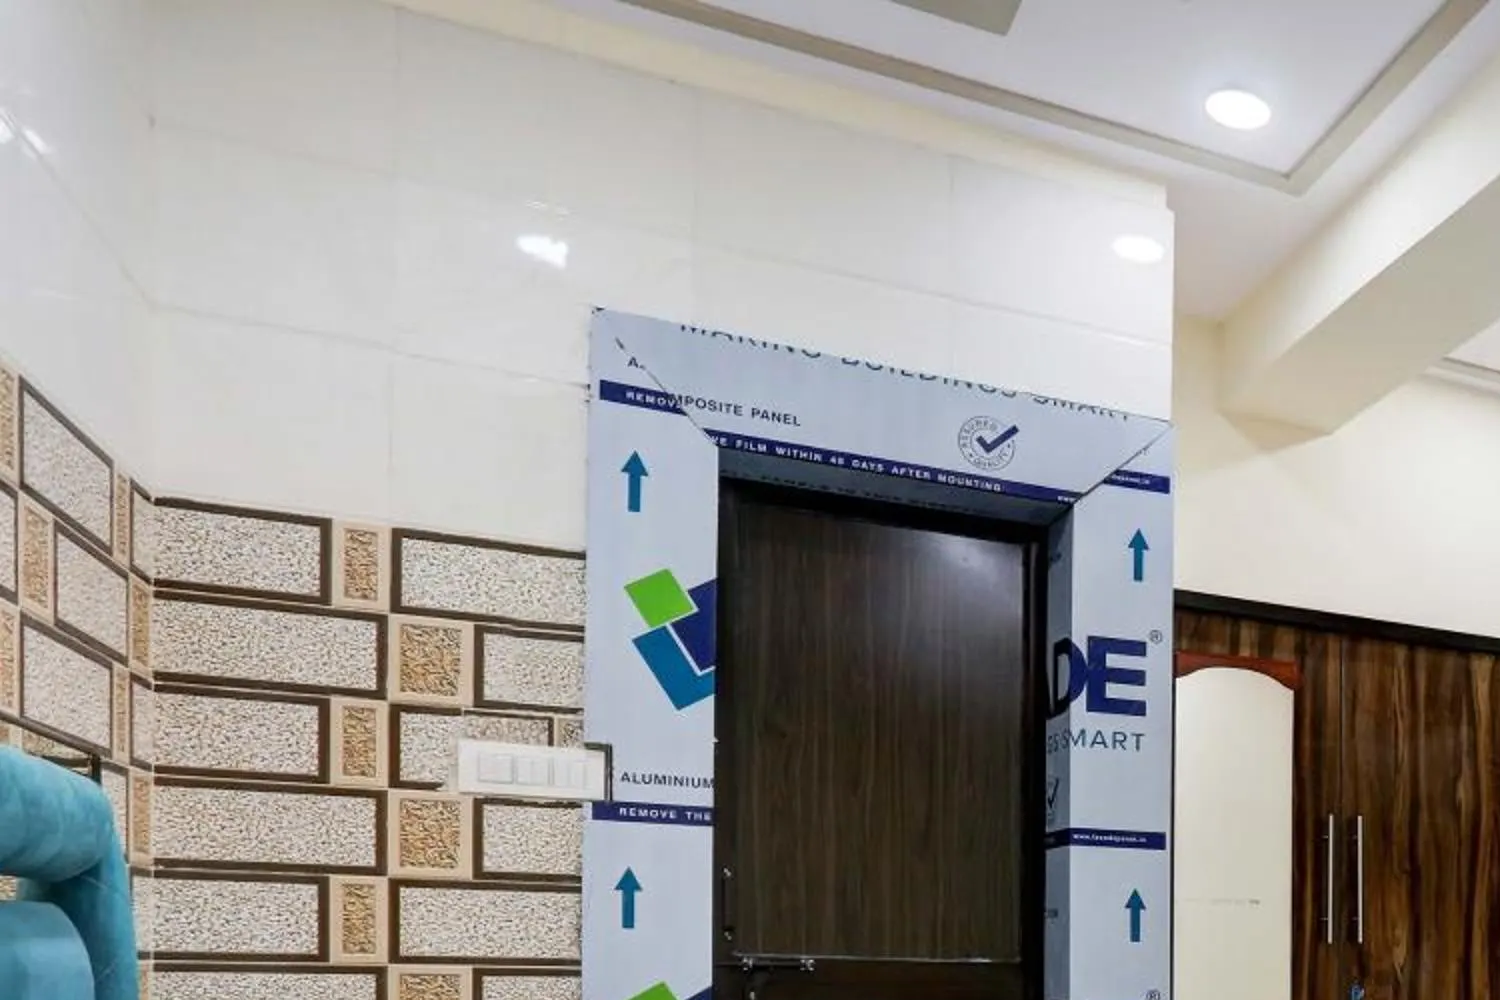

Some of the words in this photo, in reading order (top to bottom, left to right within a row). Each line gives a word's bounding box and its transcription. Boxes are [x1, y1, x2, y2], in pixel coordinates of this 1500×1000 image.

[751, 407, 801, 427] PANEL
[735, 439, 767, 453] FILM
[775, 446, 823, 462] WITHIN
[891, 465, 931, 480] AFTER
[937, 473, 1002, 493] MOUNTING
[1047, 635, 1147, 719] DE
[619, 806, 679, 820] REMOVE
[685, 811, 713, 822] THE
